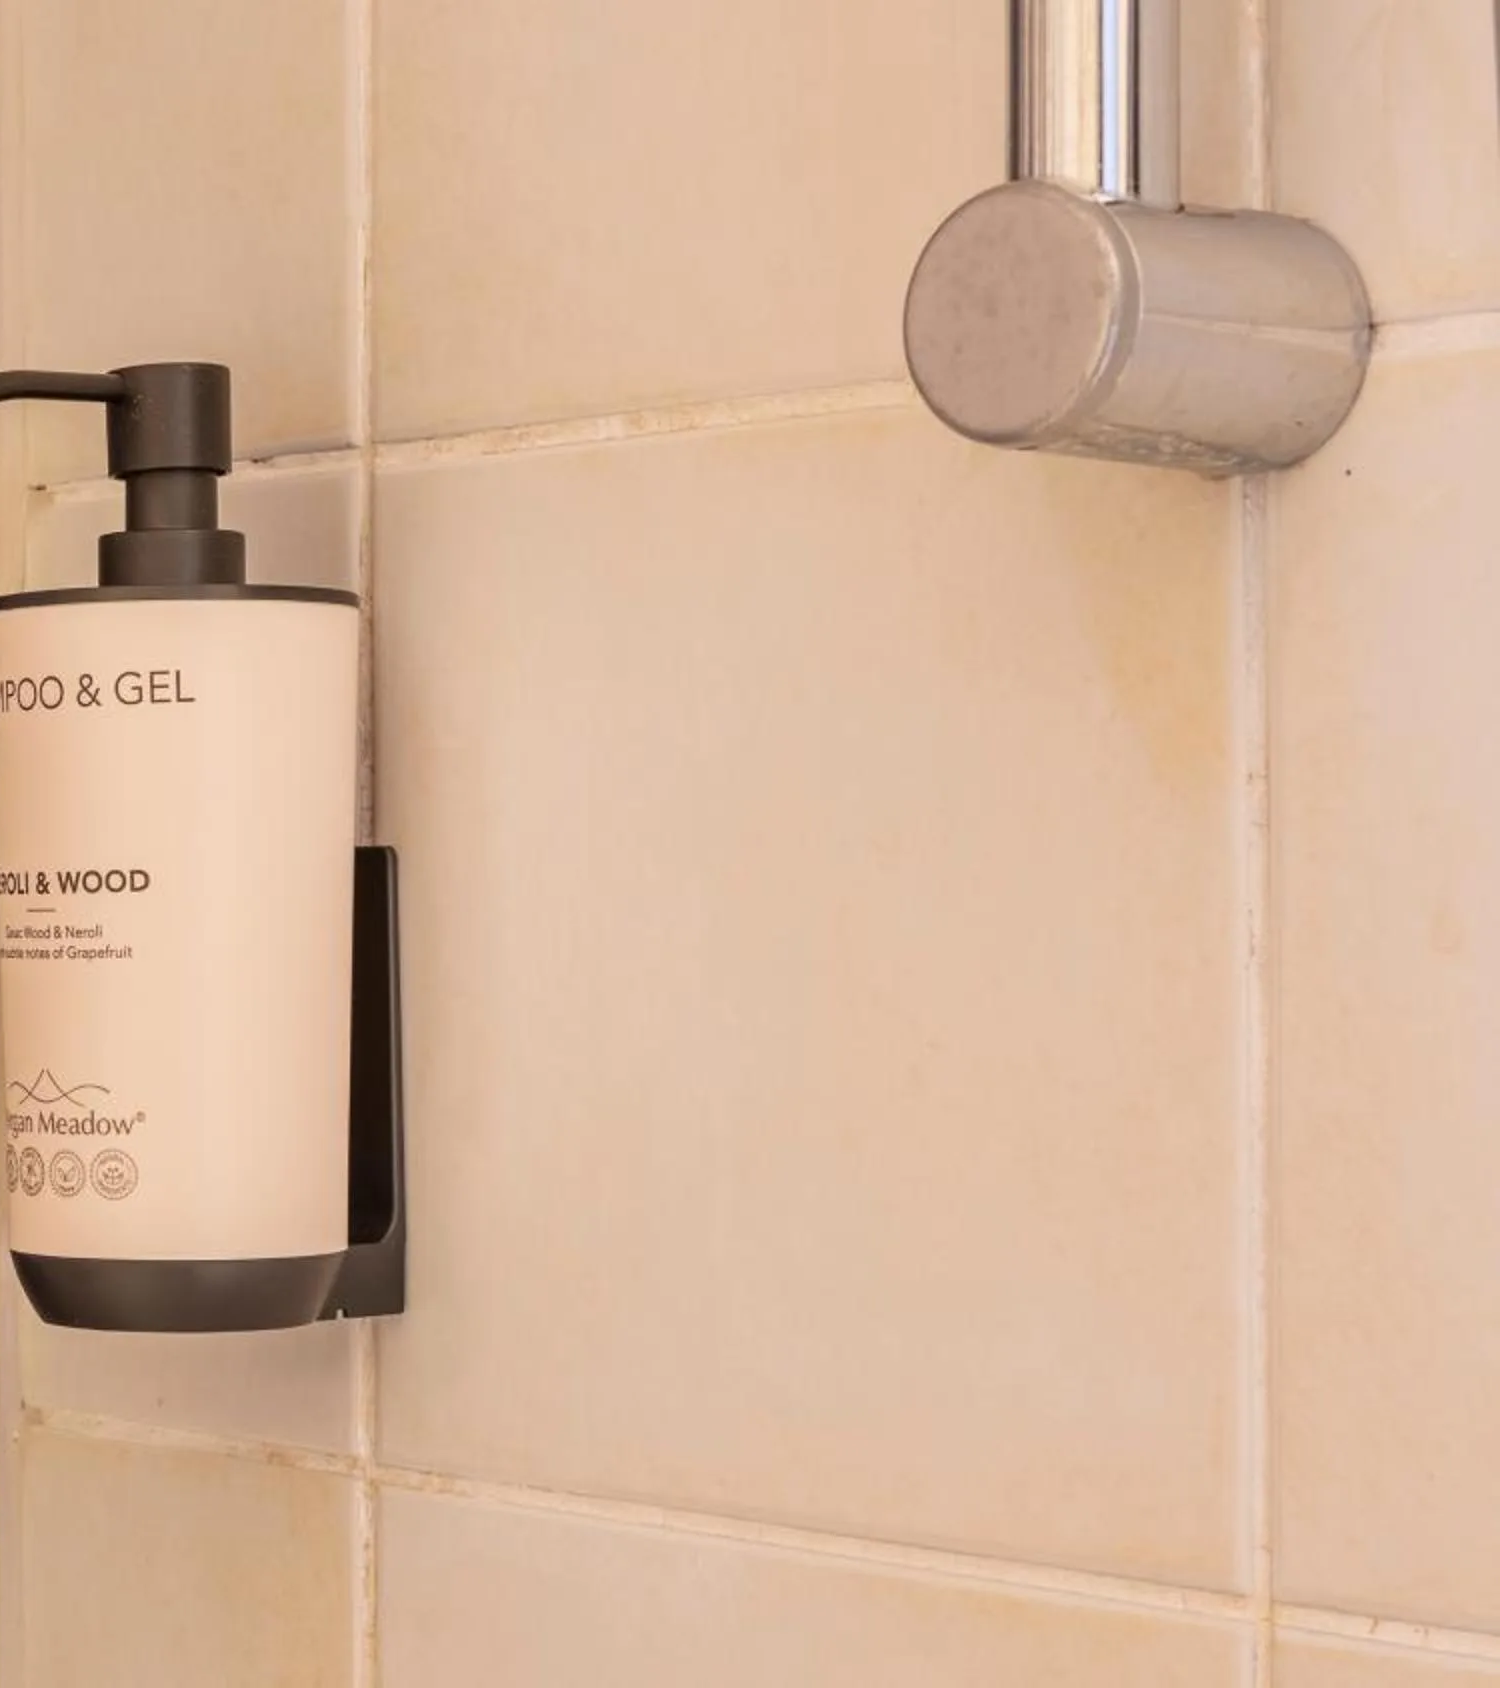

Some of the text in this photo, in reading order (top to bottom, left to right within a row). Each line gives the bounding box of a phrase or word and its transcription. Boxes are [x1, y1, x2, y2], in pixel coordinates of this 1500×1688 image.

[76, 673, 103, 708] &
[114, 669, 196, 705] GEL
[35, 871, 51, 895] &
[57, 869, 150, 895] WOOD
[65, 923, 102, 939] Neroli
[52, 945, 66, 959] of
[67, 944, 132, 962] Grapefruit
